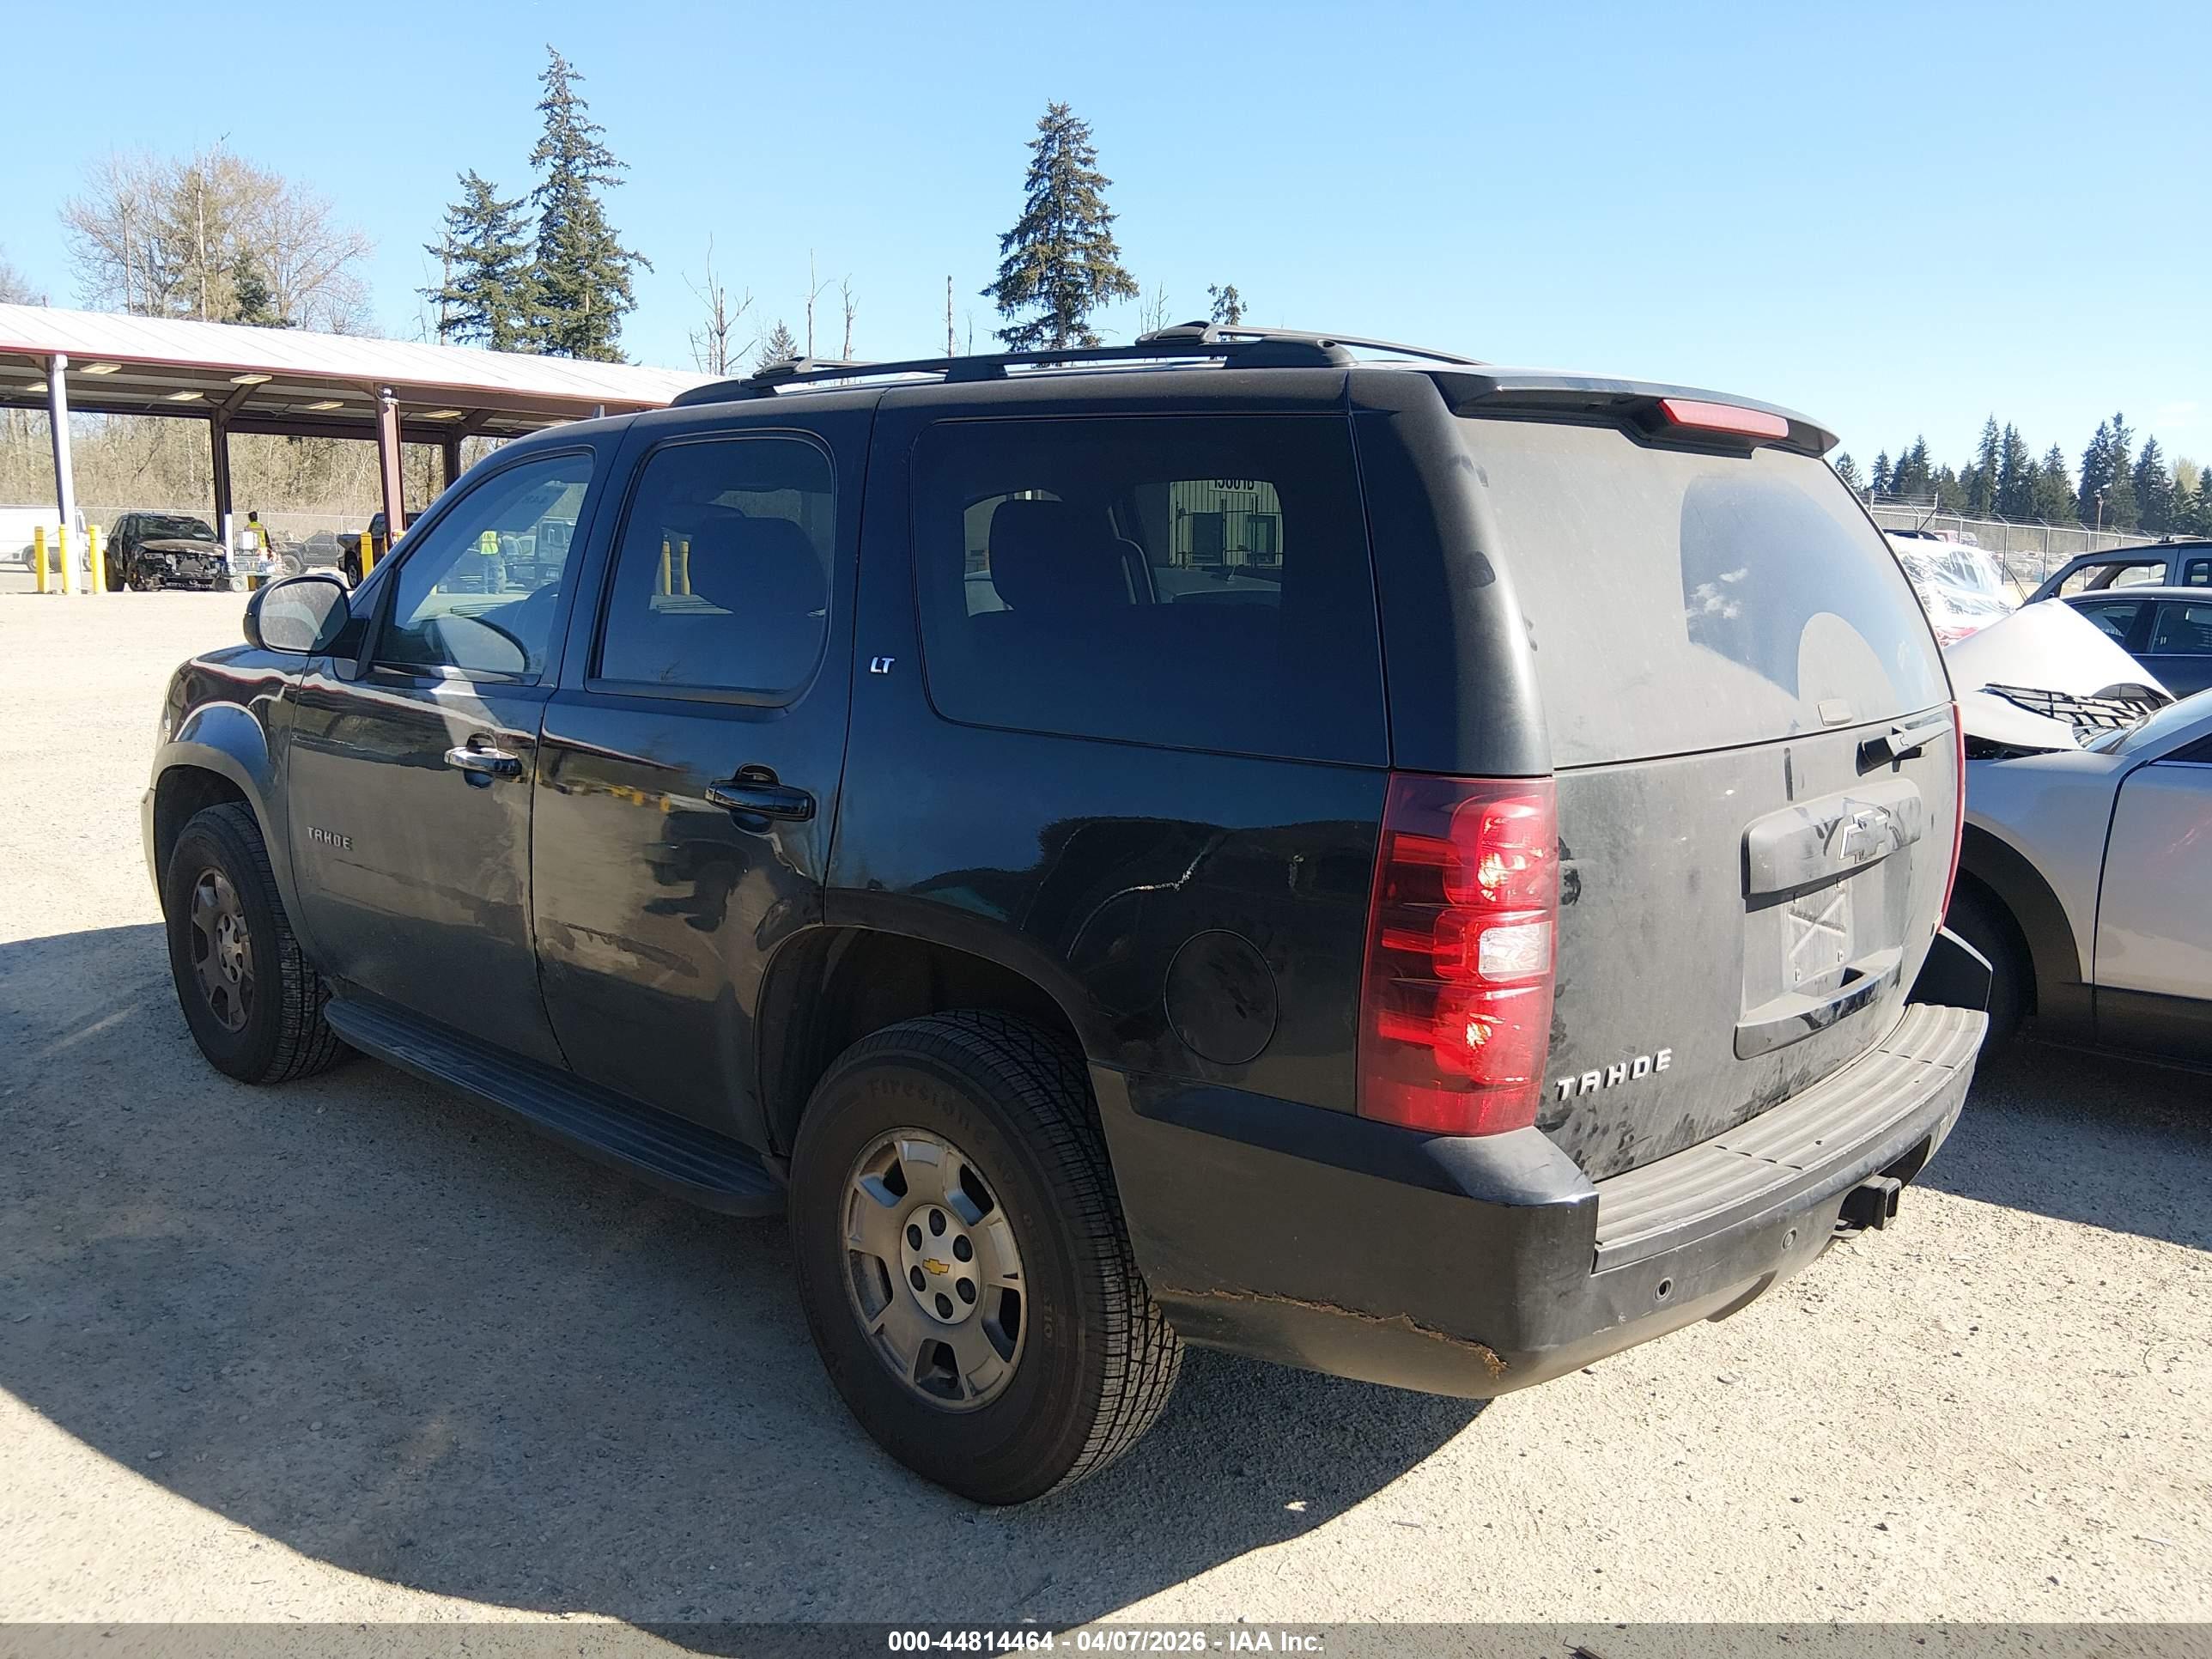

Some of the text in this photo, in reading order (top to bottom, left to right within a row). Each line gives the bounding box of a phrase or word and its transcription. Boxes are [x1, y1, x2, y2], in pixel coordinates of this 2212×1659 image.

[870, 656, 896, 674] LT
[307, 825, 352, 850] TAHOE
[1554, 1048, 1673, 1102] TAHOE
